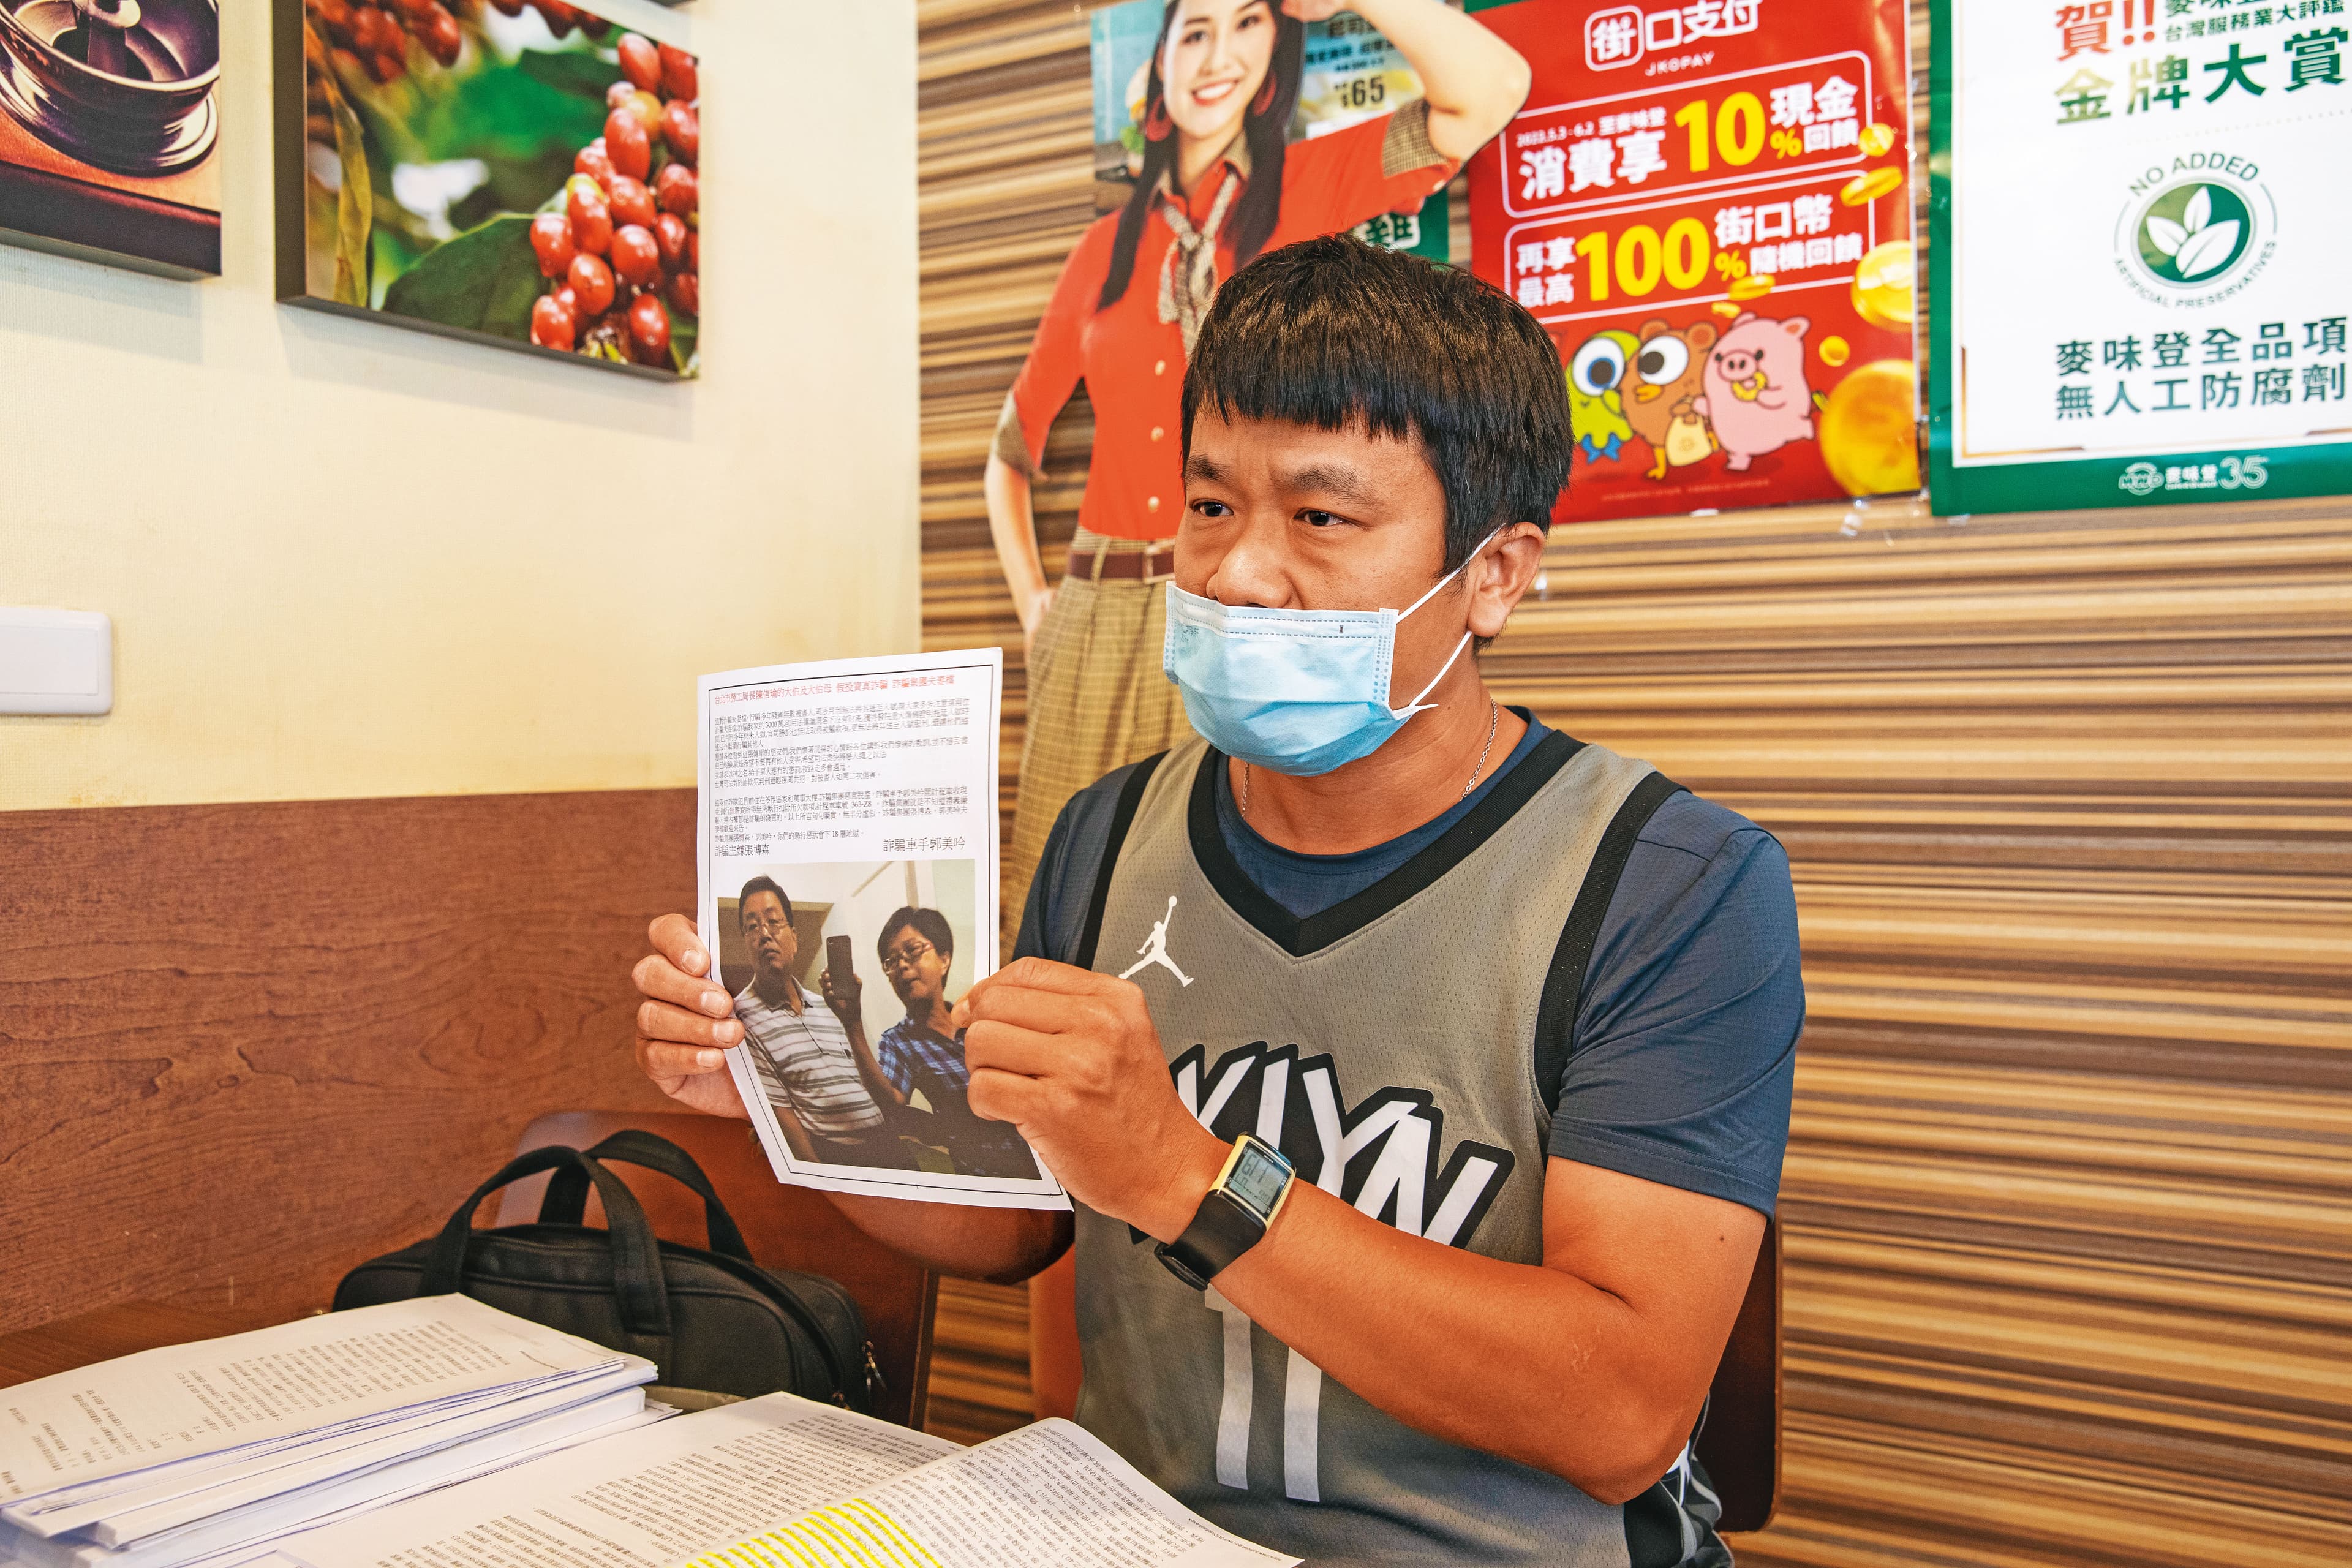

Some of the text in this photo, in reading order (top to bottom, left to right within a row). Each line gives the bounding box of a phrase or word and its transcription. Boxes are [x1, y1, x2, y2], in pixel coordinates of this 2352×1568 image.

[1593, 0, 1763, 63] 街口支付
[1645, 50, 1715, 77] JKOPAY
[2054, 26, 2349, 124] 金牌大賞
[1769, 75, 1860, 129] 現金
[1519, 130, 1667, 201] 消費享
[2129, 151, 2259, 197] NO ADDED
[1714, 193, 1833, 248] 街口幣
[1516, 236, 1577, 274] 再享
[1516, 273, 1575, 309] 最高
[2056, 317, 2346, 376] 麥味登全品項
[2056, 363, 2346, 420] 無人工防腐劑
[2218, 455, 2270, 490] 35
